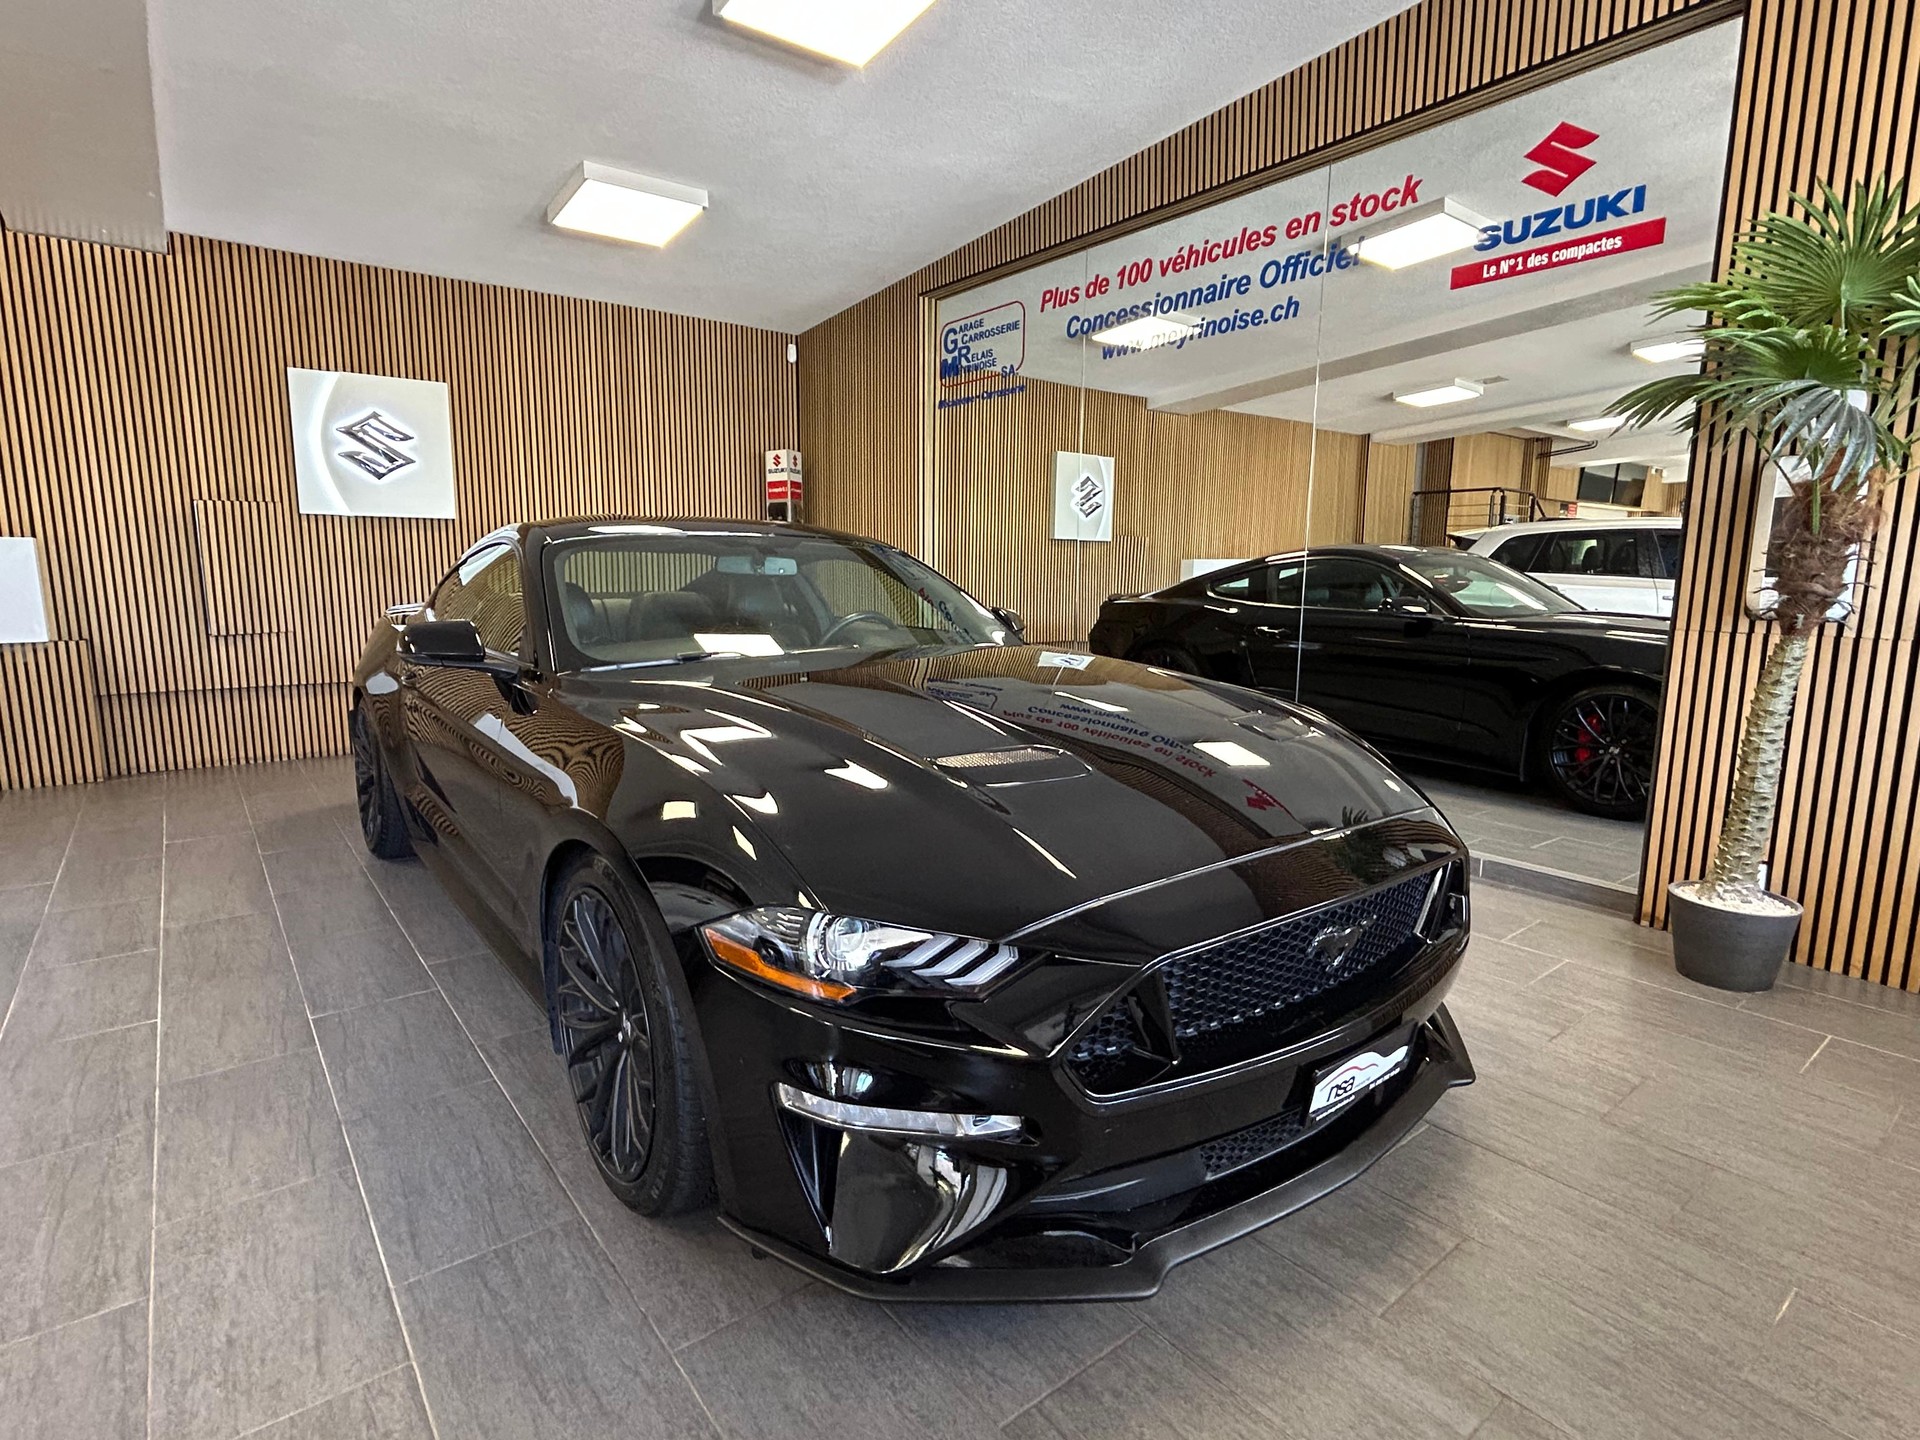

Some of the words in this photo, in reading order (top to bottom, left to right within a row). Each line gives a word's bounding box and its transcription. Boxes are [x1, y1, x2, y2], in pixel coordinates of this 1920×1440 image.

[1040, 286, 1080, 313] Plus
[1085, 274, 1110, 299] de
[1117, 258, 1153, 290] 100
[1159, 225, 1278, 278] véhicules
[1286, 211, 1321, 240] en
[1329, 174, 1424, 228] stock
[1473, 184, 1647, 252] SUZUKI
[1066, 273, 1251, 339] Concessionnaire
[1260, 235, 1366, 289] Officiel
[1482, 262, 1497, 279] Le
[1527, 251, 1549, 270] des
[1551, 235, 1623, 263] compactes
[961, 319, 1021, 346] CARROSSERIE
